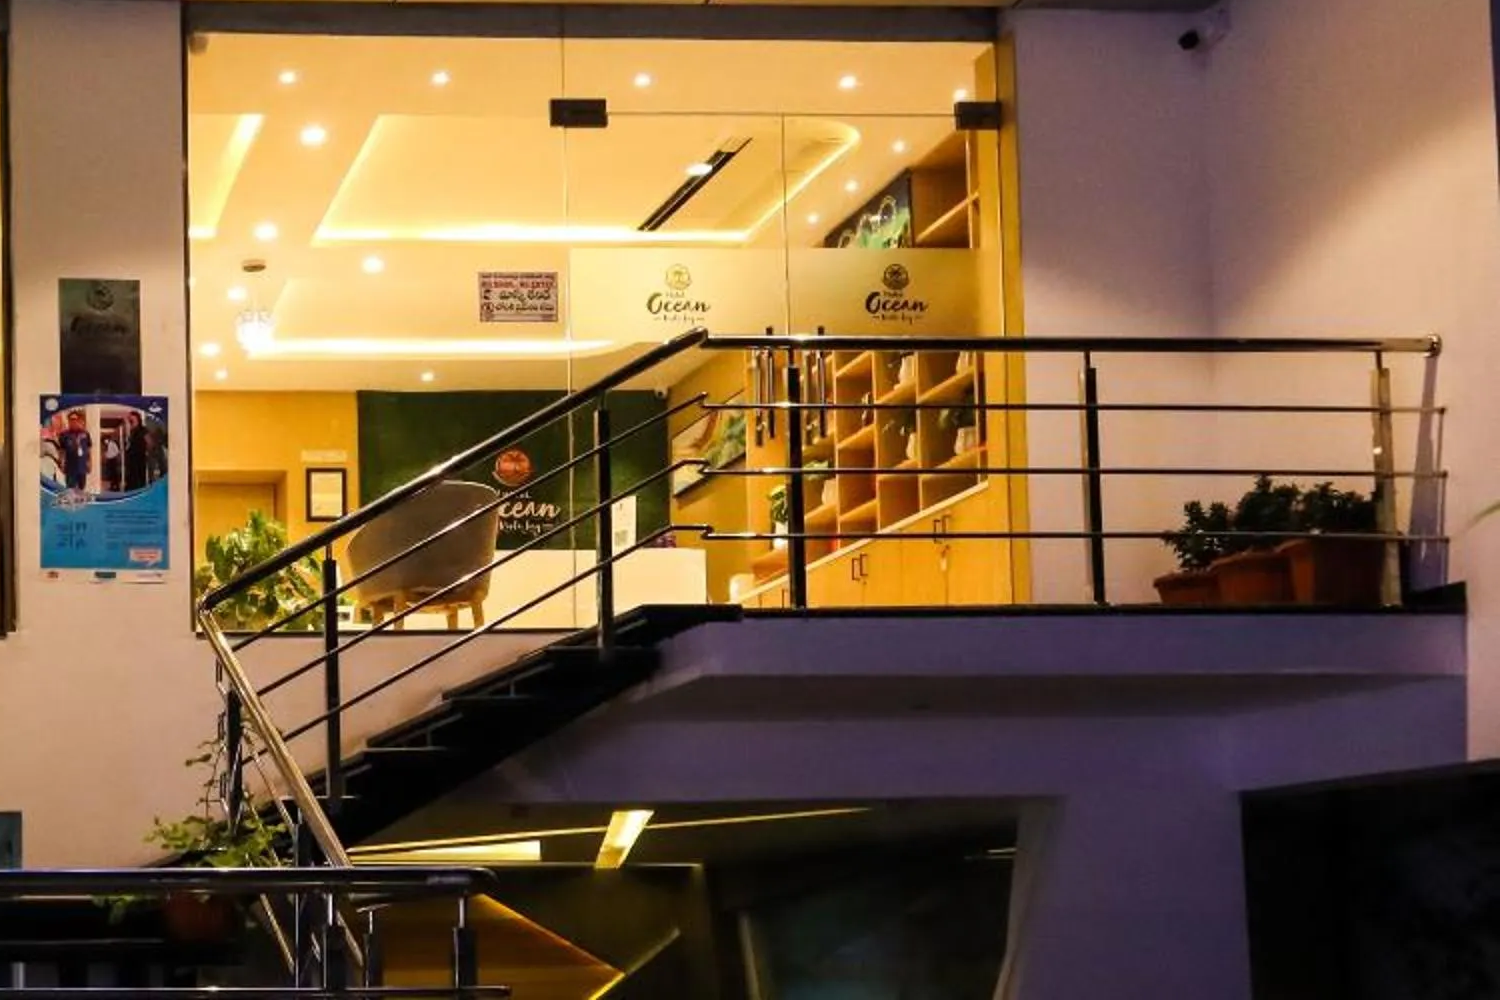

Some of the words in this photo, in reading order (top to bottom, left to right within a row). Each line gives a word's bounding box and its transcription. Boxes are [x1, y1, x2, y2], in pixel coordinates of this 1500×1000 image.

[646, 292, 711, 315] Ocean
[865, 291, 929, 314] Ocean
[498, 501, 561, 518] cean
